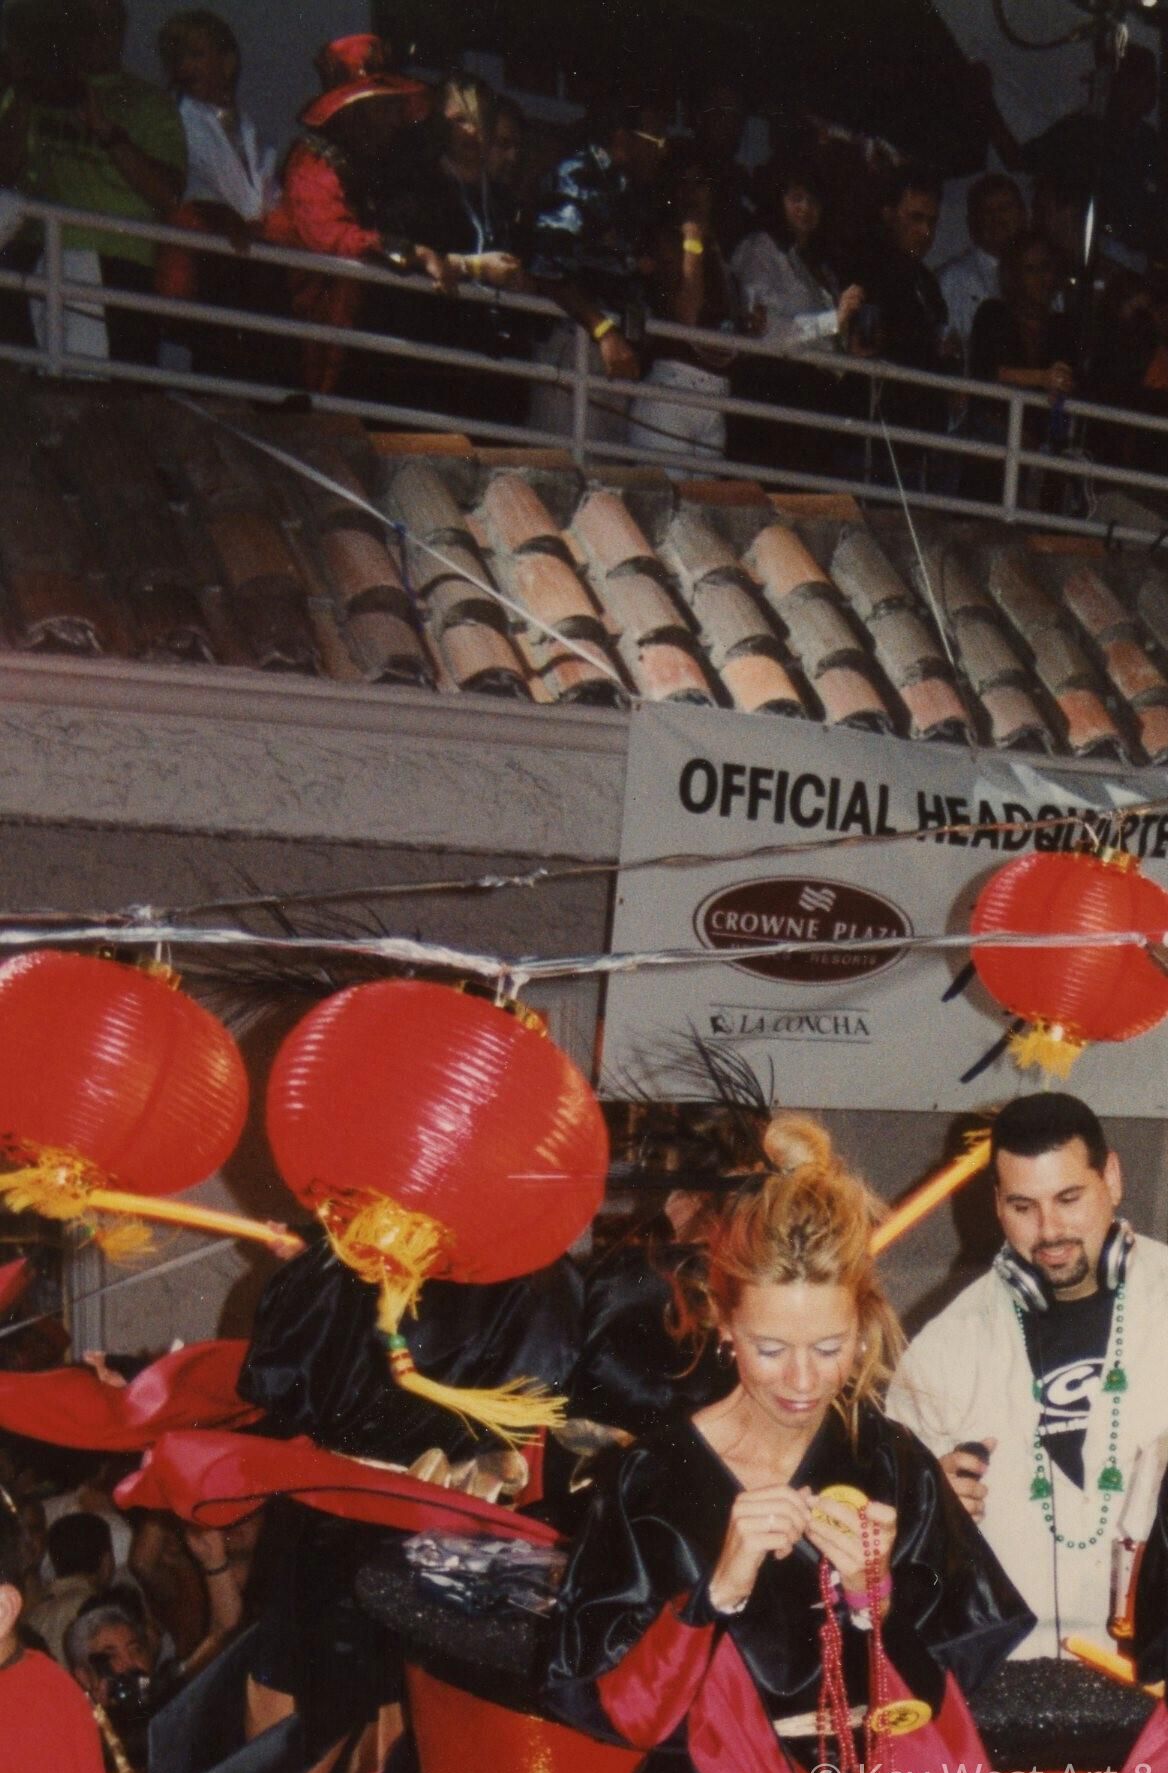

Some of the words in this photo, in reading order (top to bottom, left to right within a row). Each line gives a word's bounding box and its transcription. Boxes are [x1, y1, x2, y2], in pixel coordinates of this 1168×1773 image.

[679, 757, 898, 836] OFFICIAL
[711, 909, 820, 940] CROWNE
[739, 1014, 765, 1033] LA
[772, 1014, 870, 1036] CONCHA
